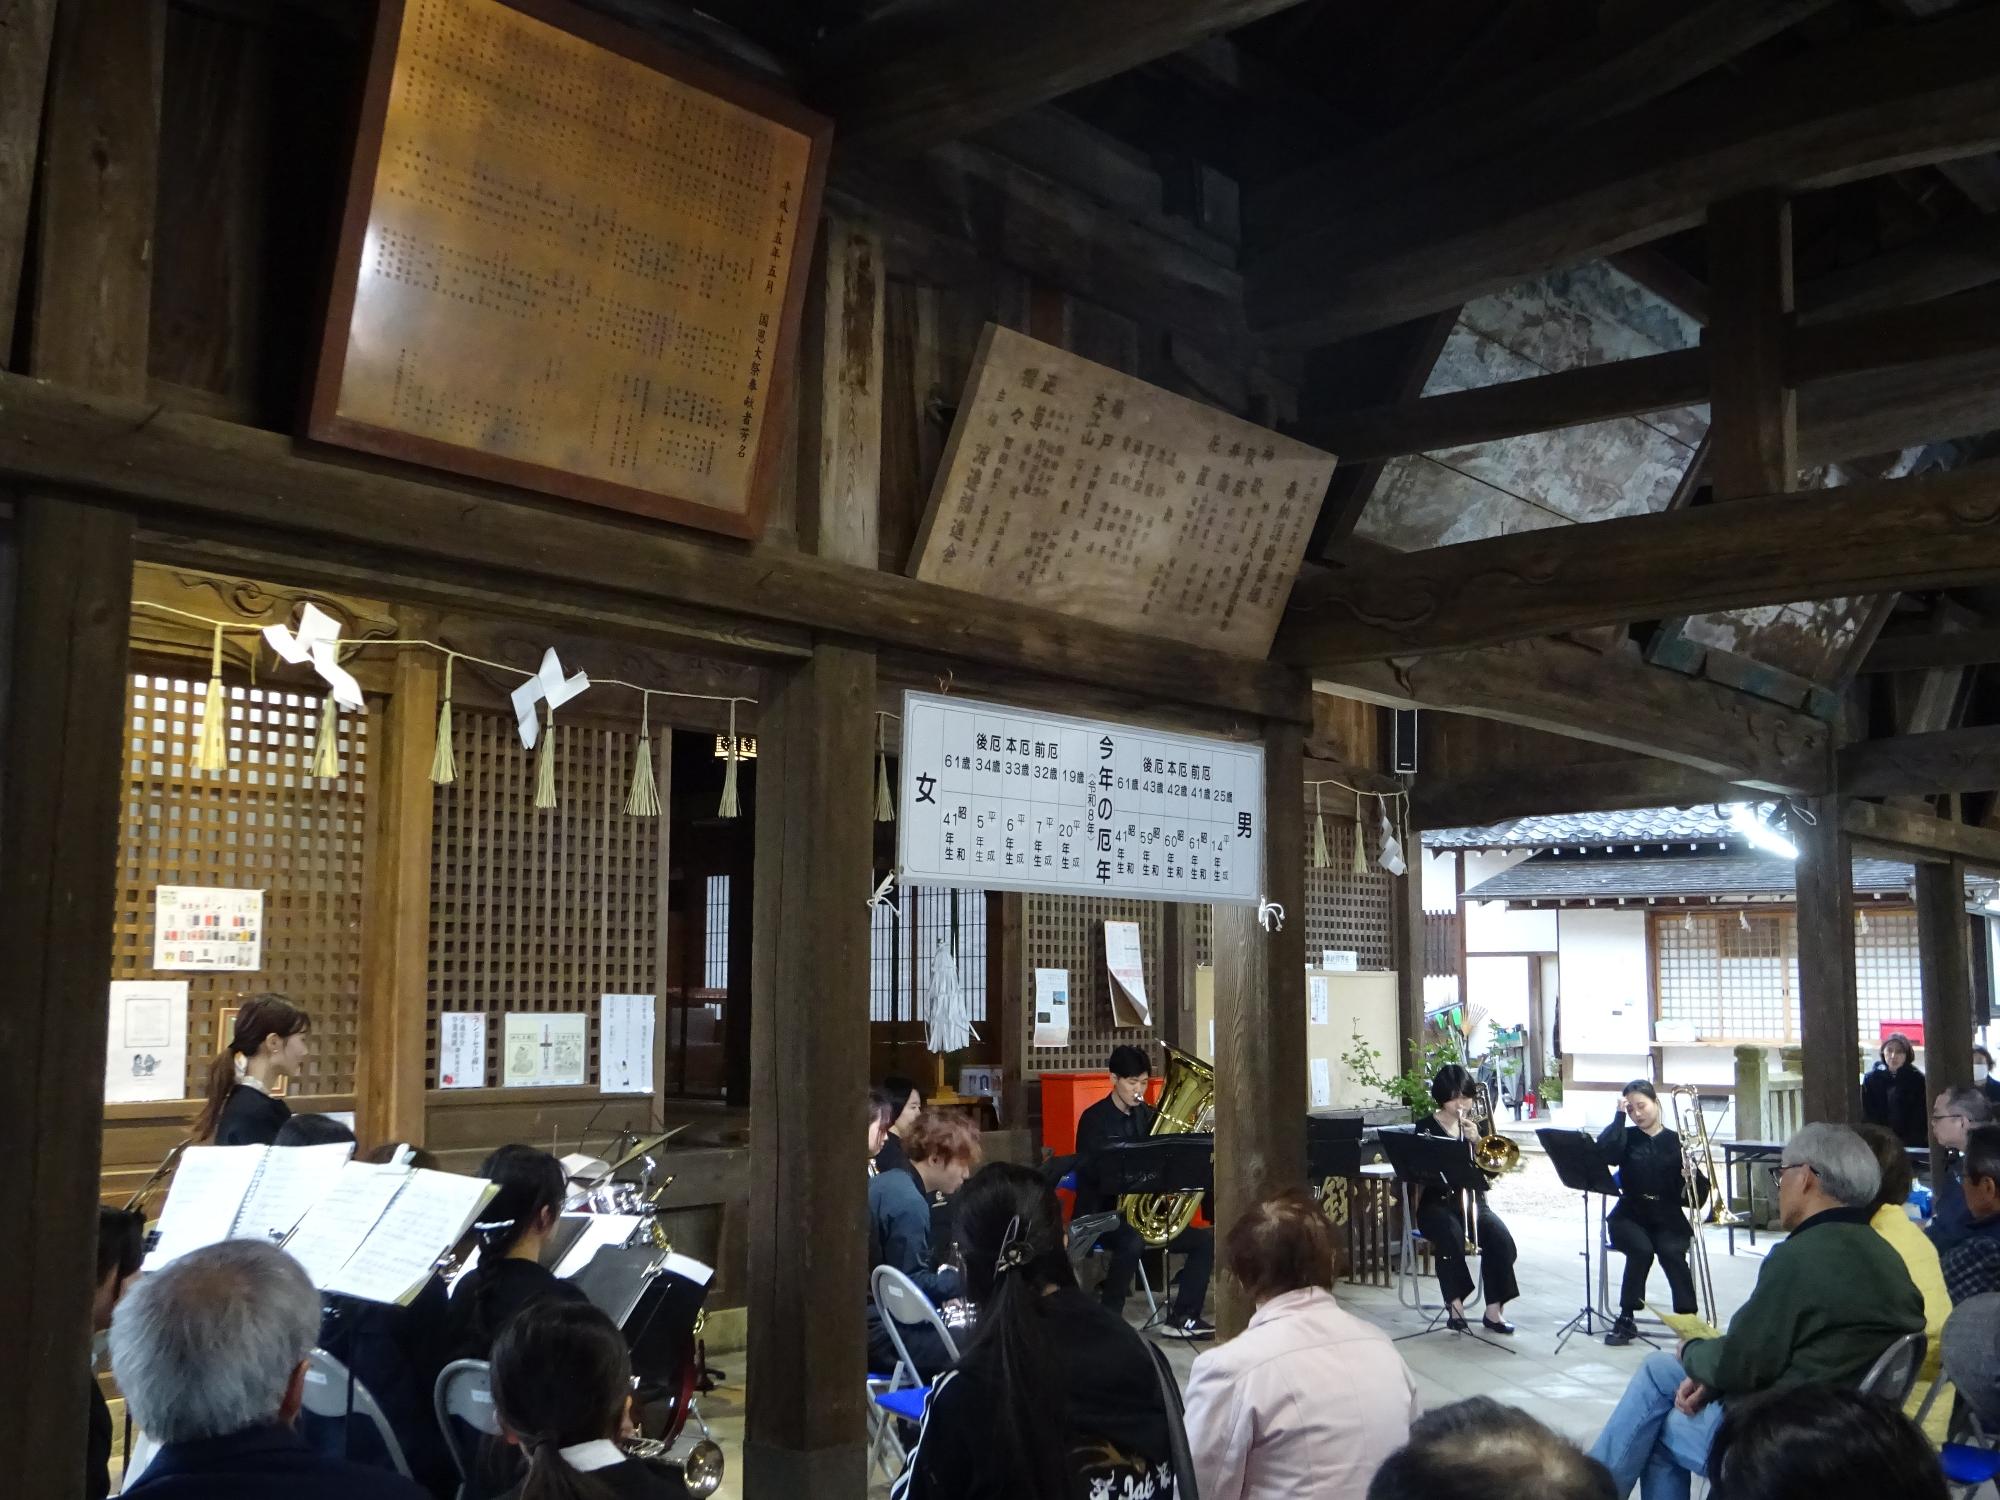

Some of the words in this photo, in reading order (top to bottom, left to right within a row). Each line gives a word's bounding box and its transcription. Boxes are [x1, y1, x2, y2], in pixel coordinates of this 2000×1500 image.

[977, 733, 1001, 752] 後厄
[1006, 737, 1030, 756] 本厄
[1035, 741, 1058, 759] 前厄
[945, 755, 970, 770] 61歳
[976, 758, 1000, 772] 34歳
[1005, 762, 1029, 776] 33歳
[1035, 767, 1057, 780] 32歳
[1063, 770, 1084, 783] 19歳
[1143, 757, 1163, 774] 後厄
[1168, 761, 1187, 777] 本厄
[1192, 765, 1211, 780] 前厄
[915, 772, 936, 804] 女
[1118, 777, 1138, 790] 61歳
[1143, 781, 1163, 794] 43歳
[1168, 785, 1187, 797] 42歳
[1191, 788, 1210, 800] 41歳
[1214, 790, 1232, 803] 25歳
[1096, 735, 1114, 884] 今年の厄年
[1237, 812, 1252, 838] 男
